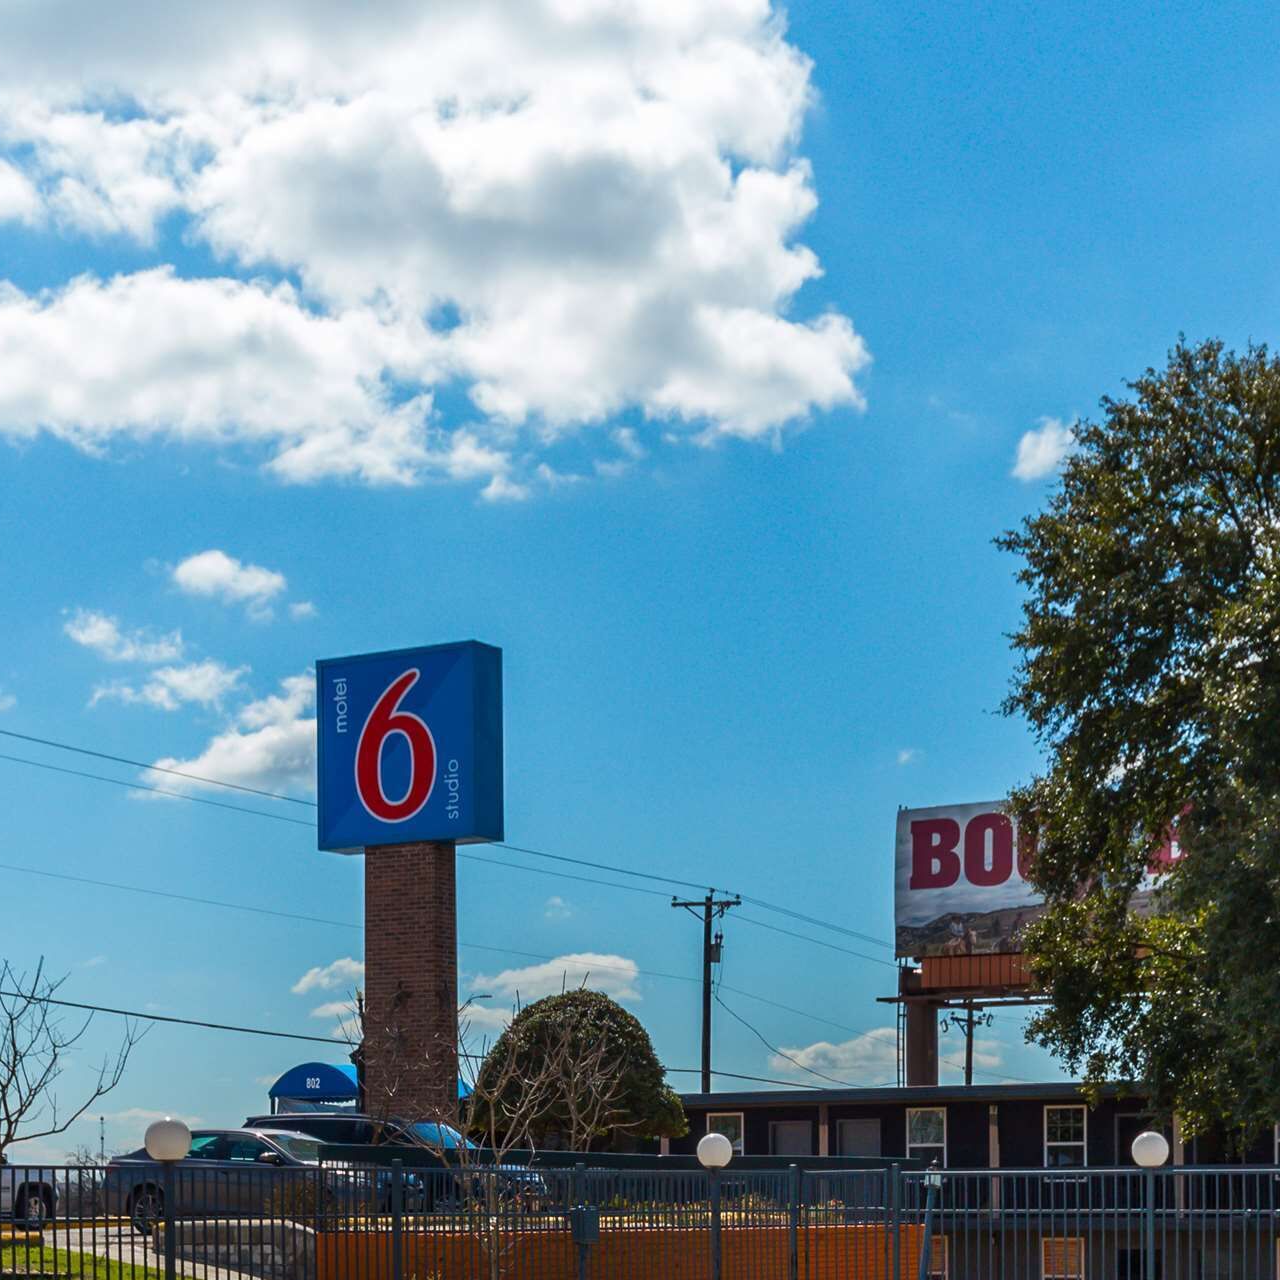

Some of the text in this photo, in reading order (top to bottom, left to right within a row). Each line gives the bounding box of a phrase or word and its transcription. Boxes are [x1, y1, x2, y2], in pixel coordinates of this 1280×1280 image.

[333, 678, 348, 733] motel
[354, 667, 438, 824] 6
[444, 758, 460, 820] studio
[306, 1077, 321, 1089] 802
